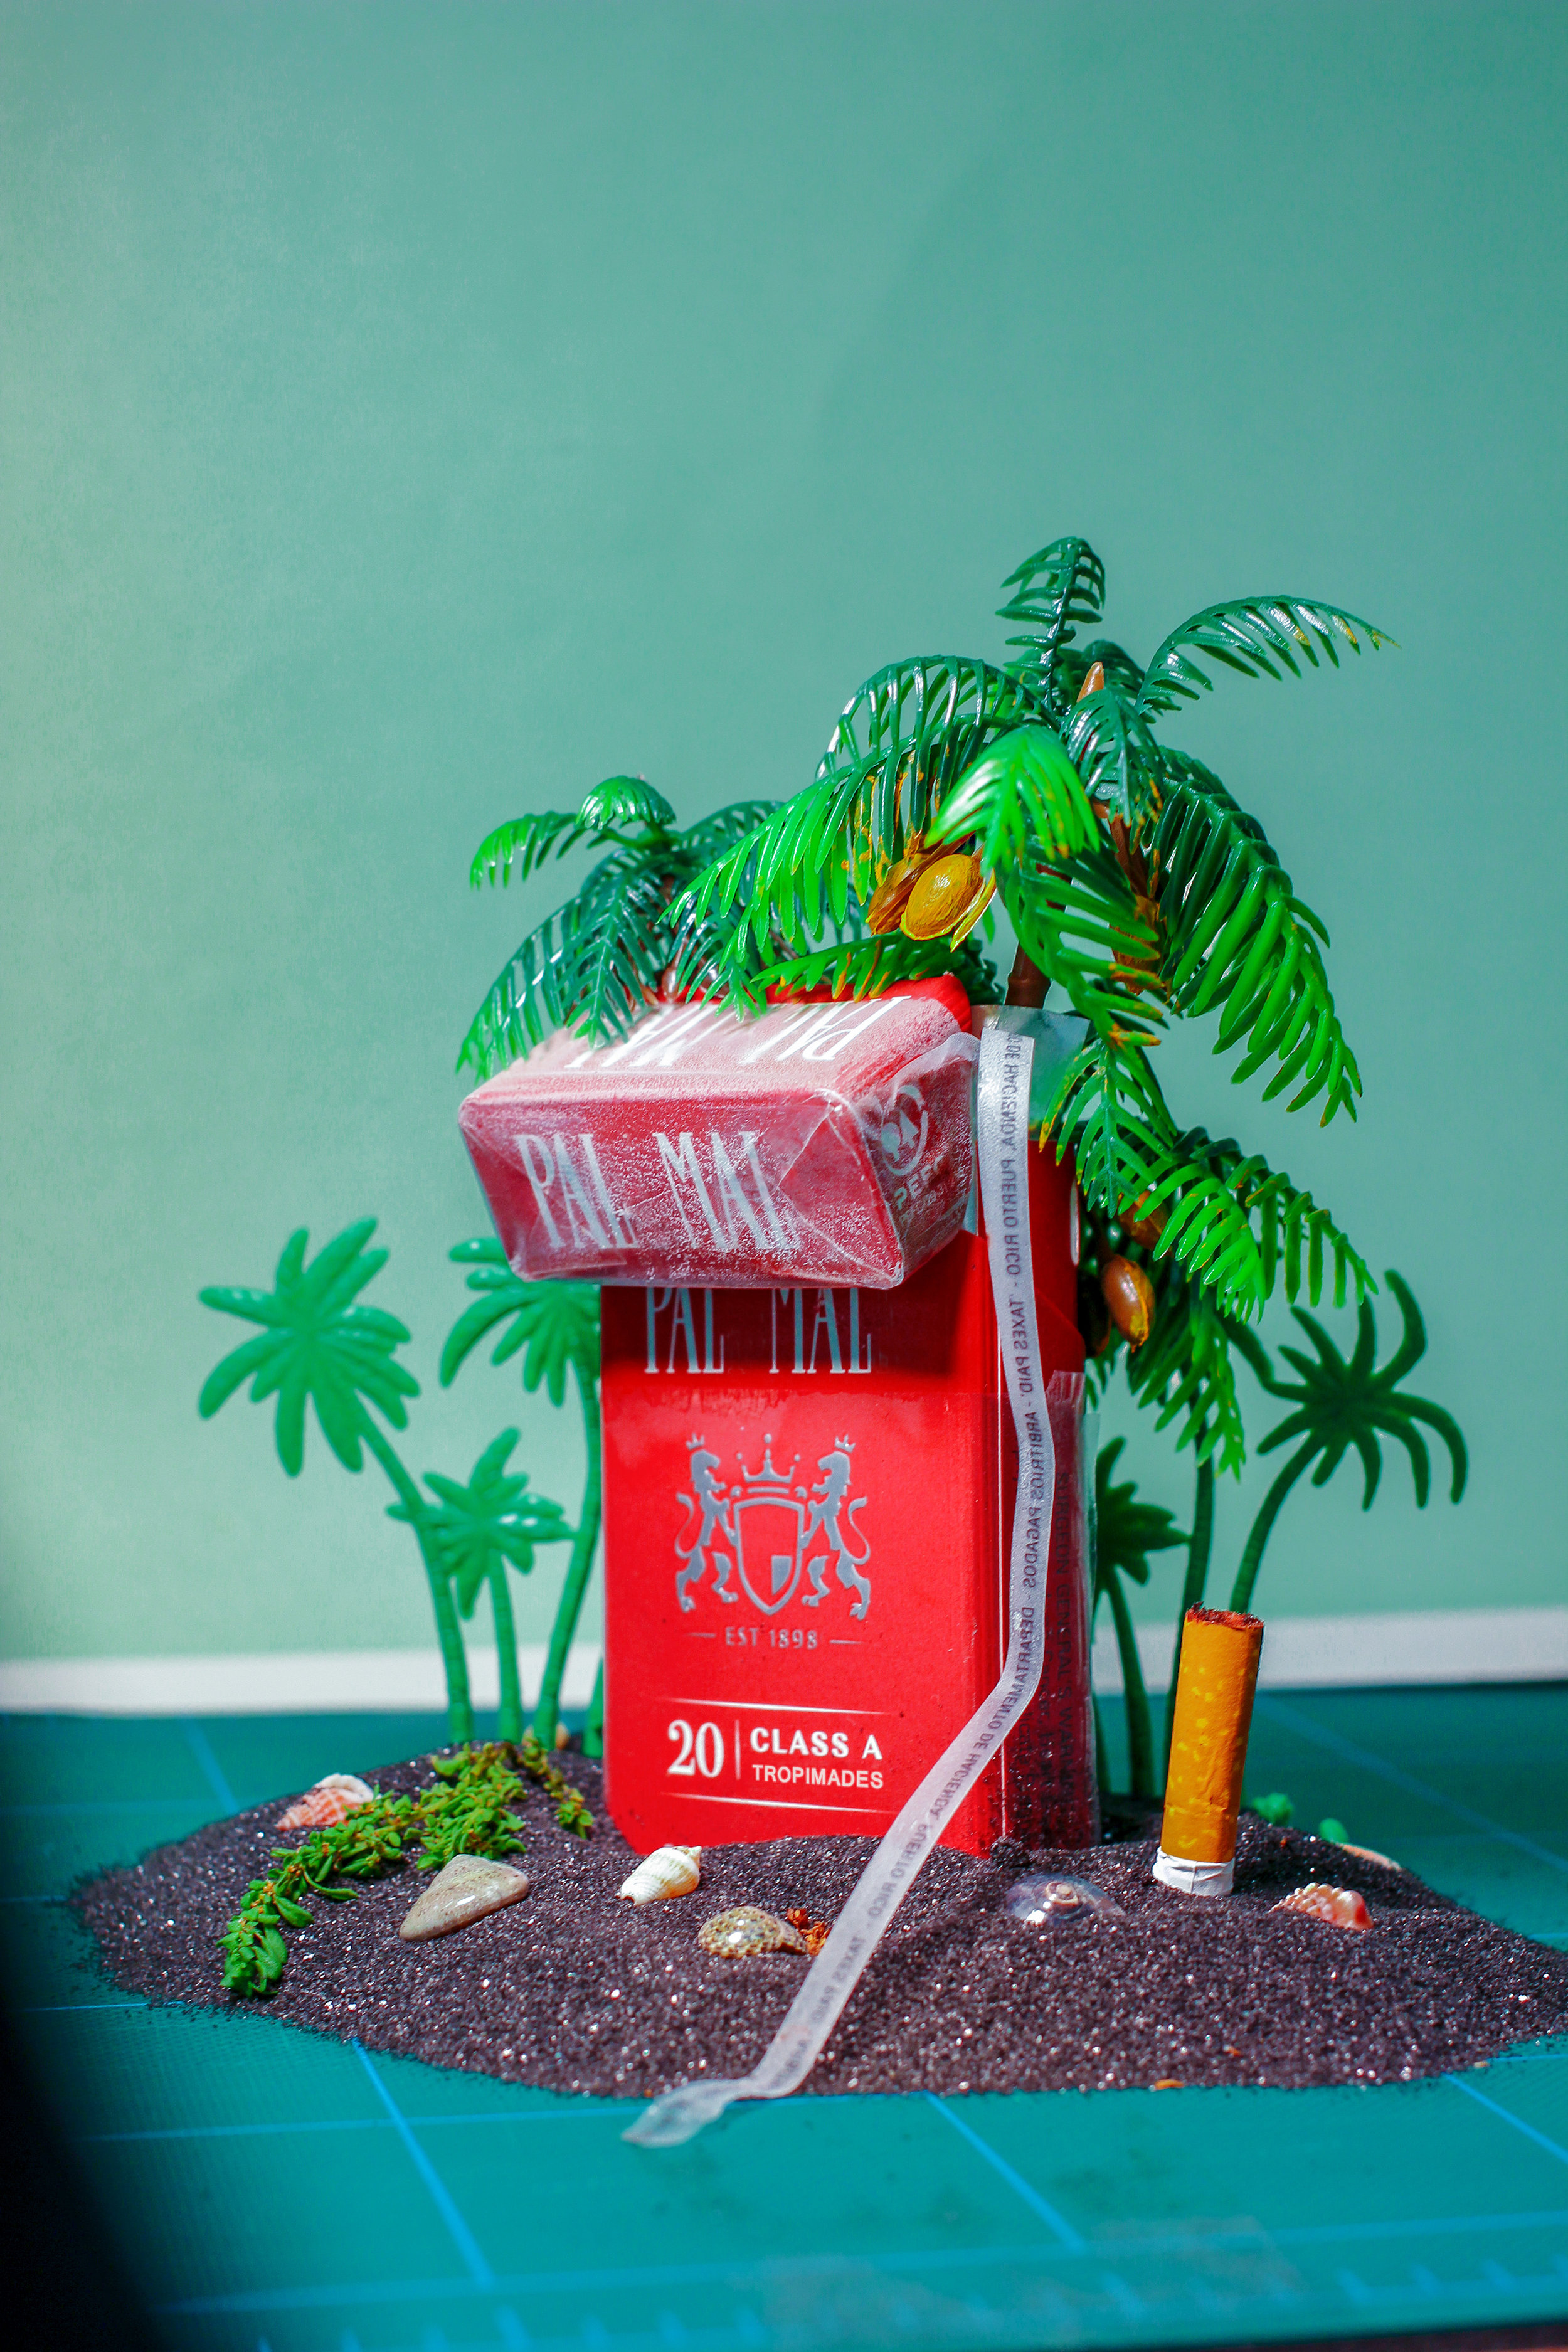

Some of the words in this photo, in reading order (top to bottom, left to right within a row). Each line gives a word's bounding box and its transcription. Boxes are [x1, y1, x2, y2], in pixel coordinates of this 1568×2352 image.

[514, 1133, 638, 1250] PAL
[653, 1129, 800, 1252] MAL
[646, 1287, 724, 1374] PAL
[770, 1287, 872, 1375] MAL
[725, 1626, 759, 1647] EST
[770, 1629, 818, 1650] 1898
[667, 1719, 724, 1777] 20
[750, 1726, 850, 1758] CLASS
[862, 1734, 883, 1760] A
[752, 1764, 884, 1789] TROPIMADES
